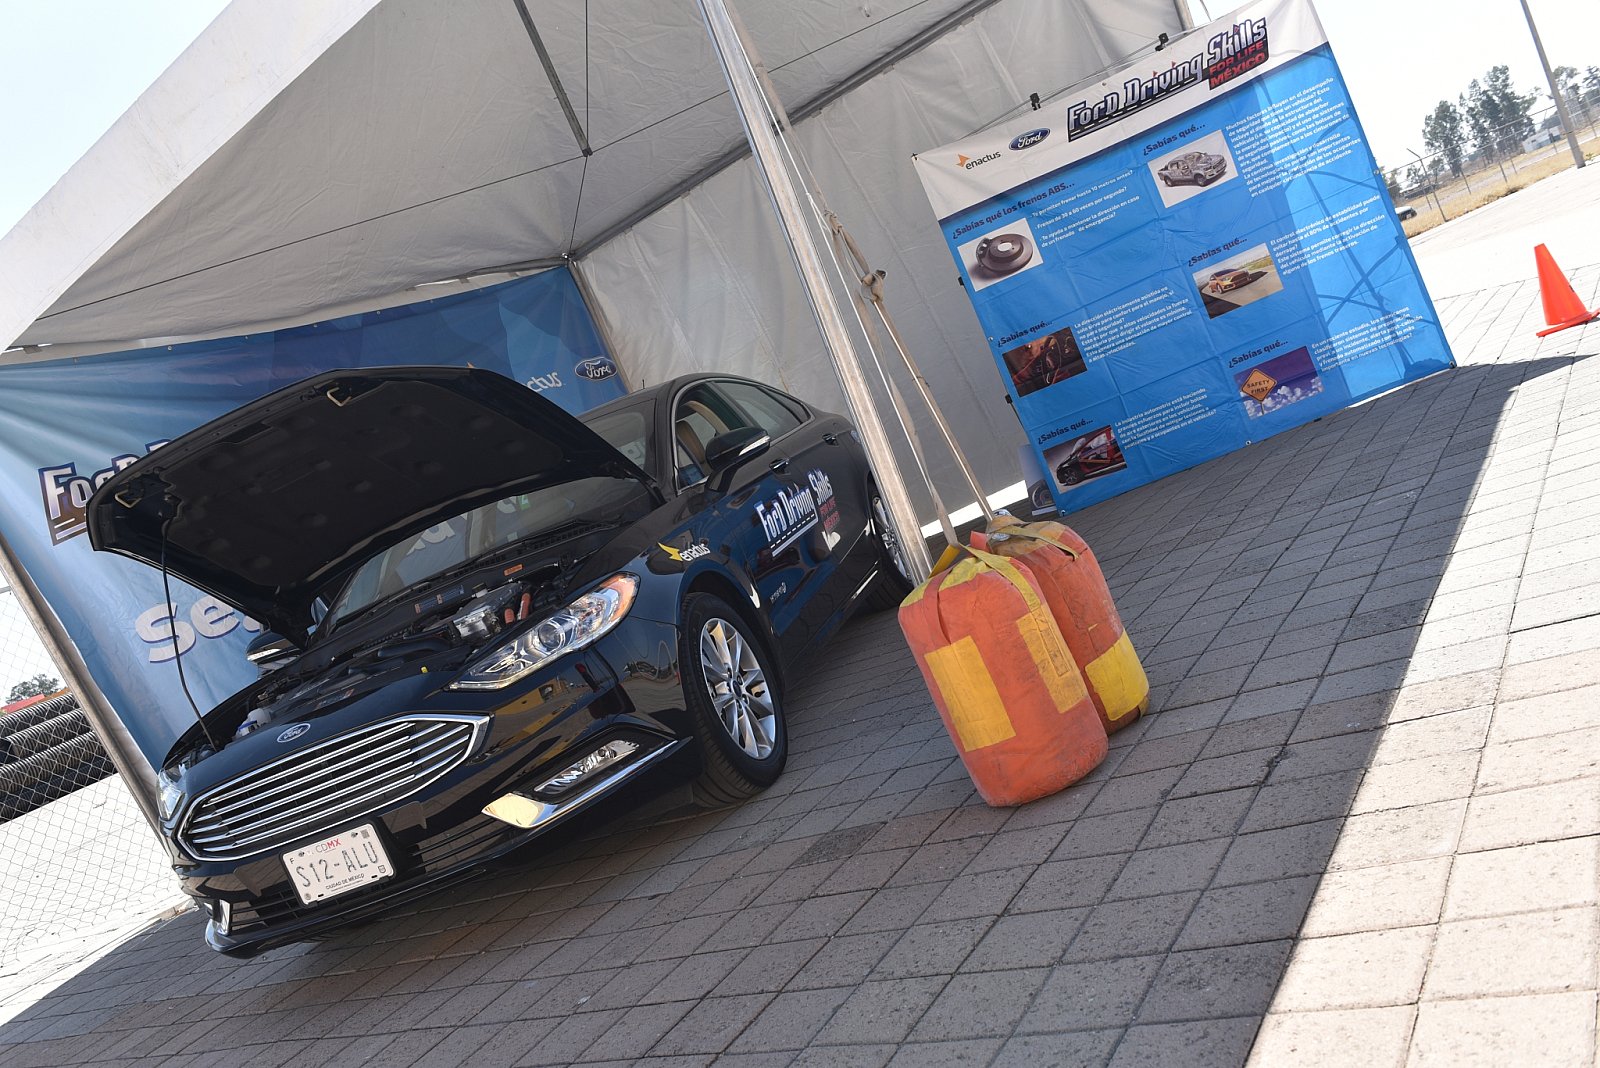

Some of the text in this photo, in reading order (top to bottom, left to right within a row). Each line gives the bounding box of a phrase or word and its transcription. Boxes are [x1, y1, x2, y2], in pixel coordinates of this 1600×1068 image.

[1125, 54, 1203, 107] Driving
[1208, 18, 1266, 64] Skills
[1210, 41, 1264, 75] FOR LIFE
[1211, 53, 1266, 88] MÉXICO
[1143, 135, 1176, 155] ¿Sabías
[965, 151, 1001, 170] enactus
[953, 219, 984, 238] ¿Sabías
[985, 210, 1001, 222] qué
[1002, 205, 1017, 214] los
[1017, 192, 1046, 208] frenos
[1188, 247, 1221, 266] ¿Sabías
[998, 329, 1028, 346] ¿Sabías
[1229, 349, 1261, 367] ¿Sabías
[525, 371, 563, 393] ctus
[1247, 379, 1270, 389] SAFETY
[1251, 386, 1269, 394] FIRST
[1038, 426, 1068, 444] ¿Sabías
[777, 483, 818, 524] Driving
[807, 468, 834, 506] Skills
[680, 543, 711, 562] enactus
[316, 838, 341, 854] CDMX
[296, 841, 379, 888] S12-ALU
[326, 881, 341, 890] CIUDAD
